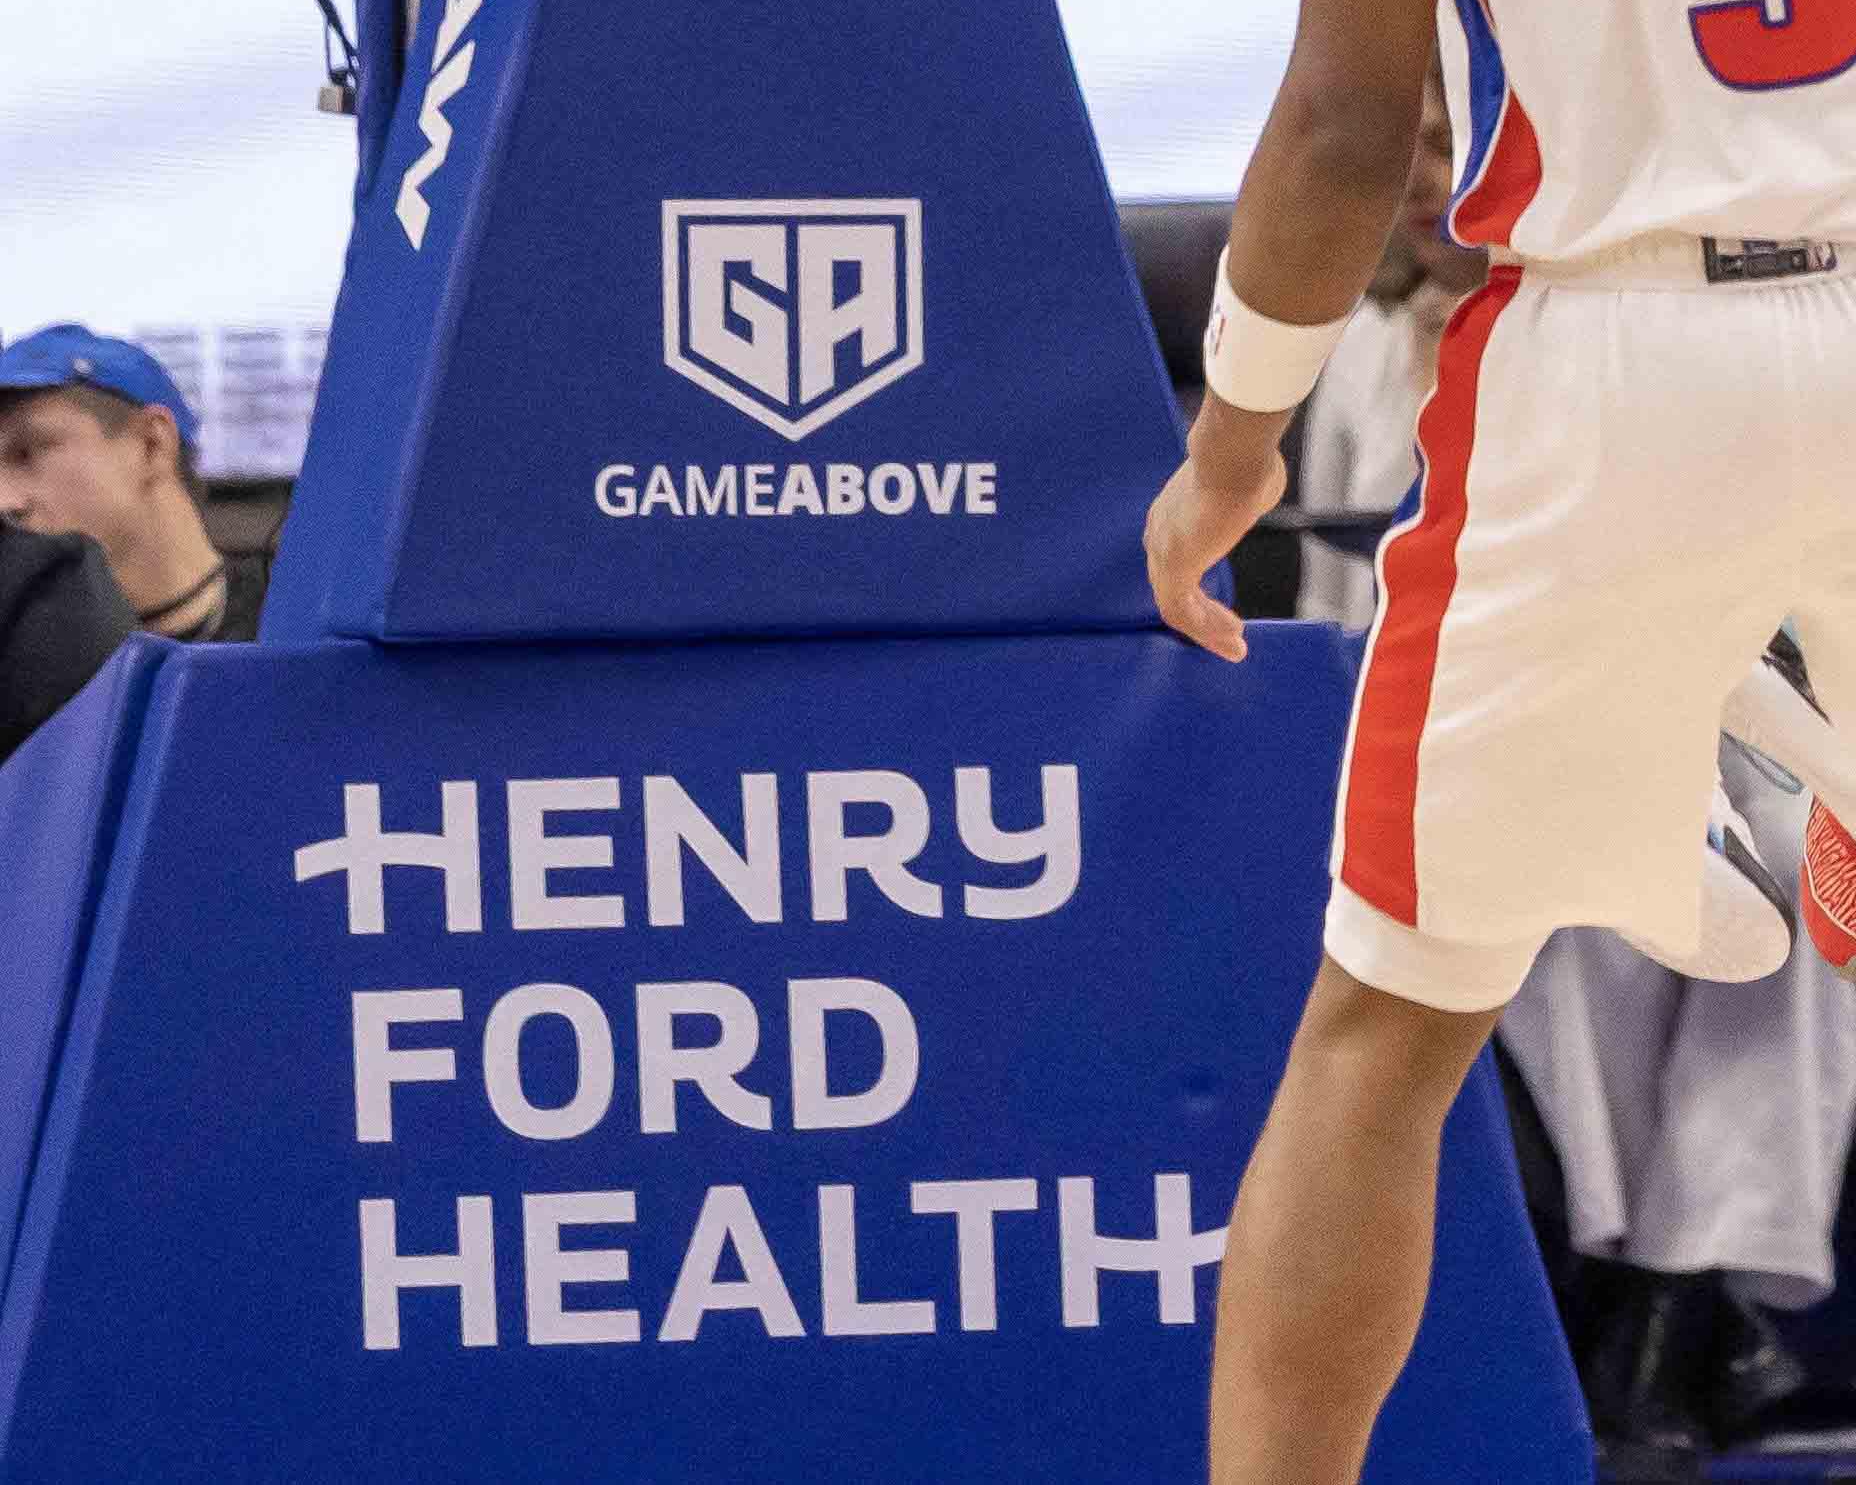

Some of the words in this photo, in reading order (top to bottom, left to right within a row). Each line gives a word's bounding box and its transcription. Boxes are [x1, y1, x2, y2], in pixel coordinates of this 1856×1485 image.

[594, 461, 997, 518] GAMEABOVE
[293, 763, 1083, 935] HENRY
[351, 977, 920, 1143] FORD
[358, 1173, 1229, 1351] HEALTH
